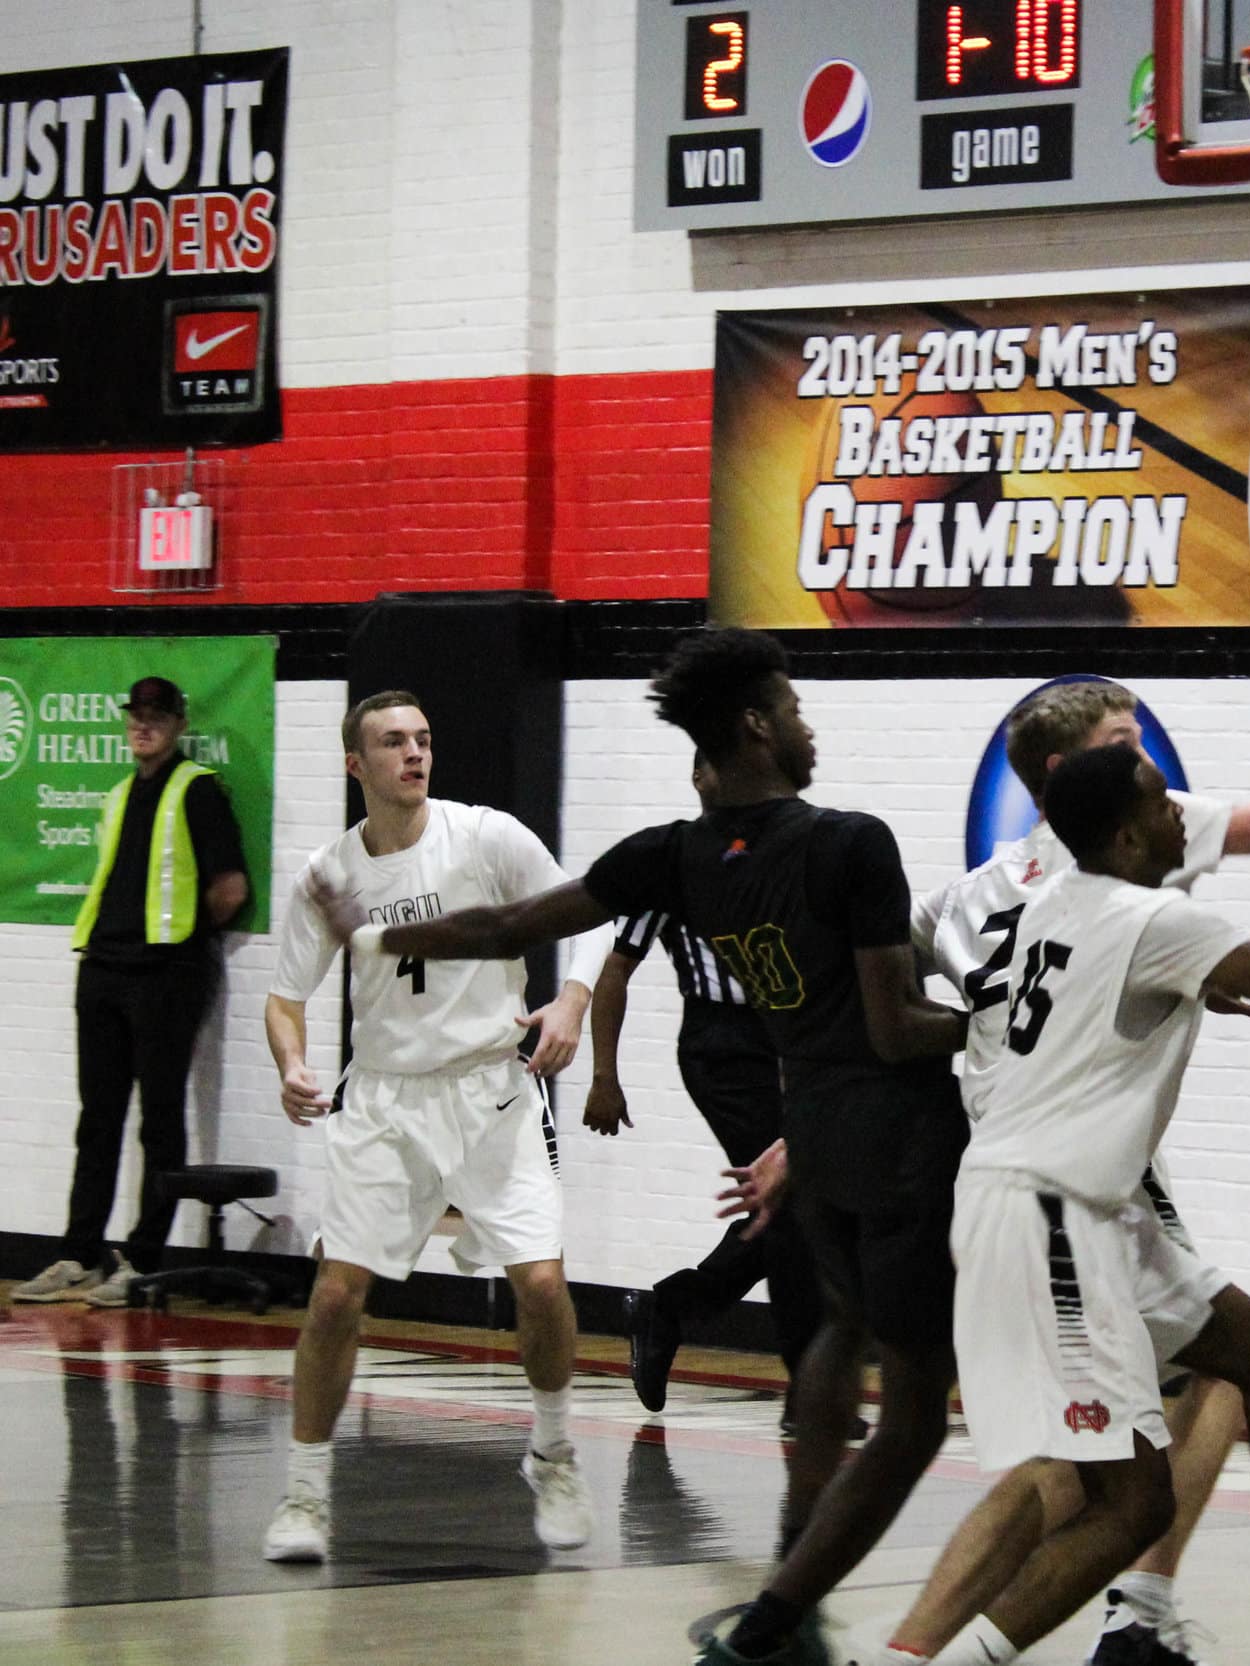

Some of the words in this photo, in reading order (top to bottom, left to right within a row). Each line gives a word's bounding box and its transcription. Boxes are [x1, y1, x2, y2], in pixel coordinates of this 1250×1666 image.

[703, 21, 743, 110] 2
[103, 87, 193, 196] DO
[198, 79, 275, 188] IT.
[682, 146, 746, 189] won
[952, 124, 1041, 183] game
[797, 325, 1031, 397] 2014-2015
[151, 510, 193, 562] EXIT
[711, 923, 805, 1010] 10
